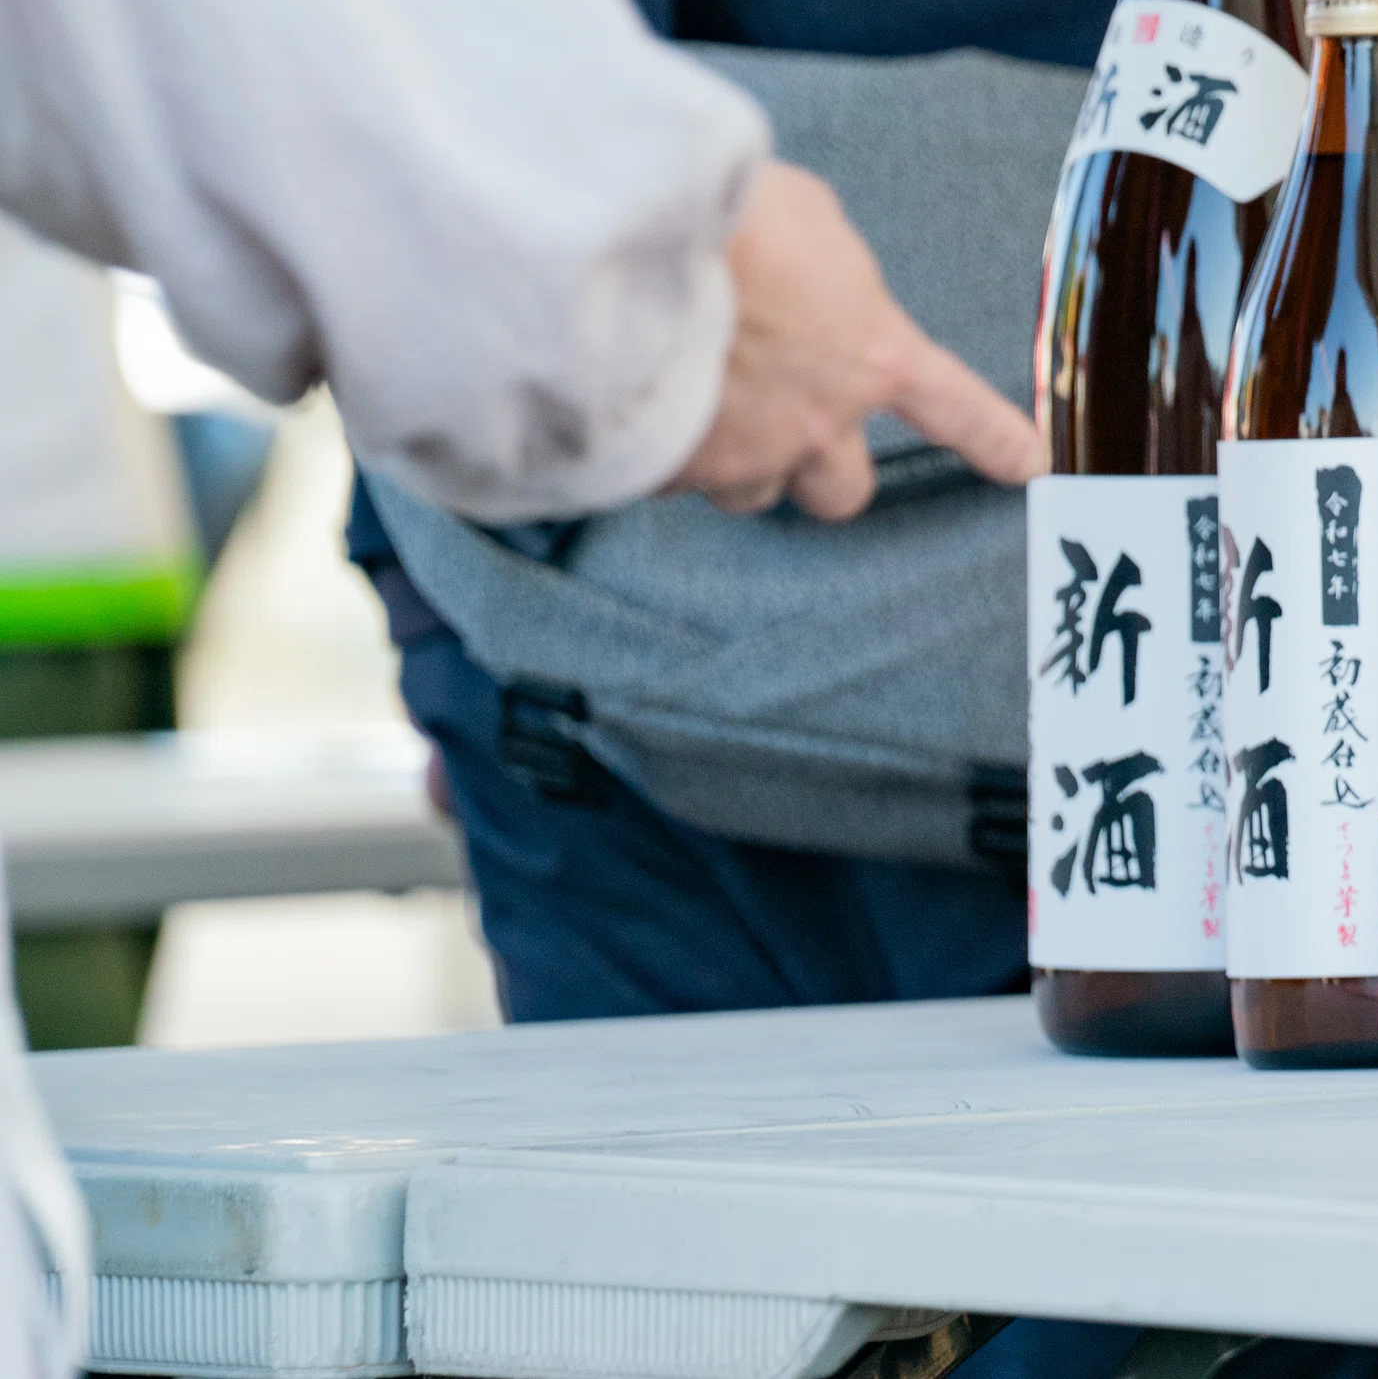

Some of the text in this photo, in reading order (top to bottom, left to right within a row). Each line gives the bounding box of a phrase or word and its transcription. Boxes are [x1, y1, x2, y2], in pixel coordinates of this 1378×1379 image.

[1324, 490, 1350, 601] 令和七年
[1038, 534, 1167, 899] 新酒
